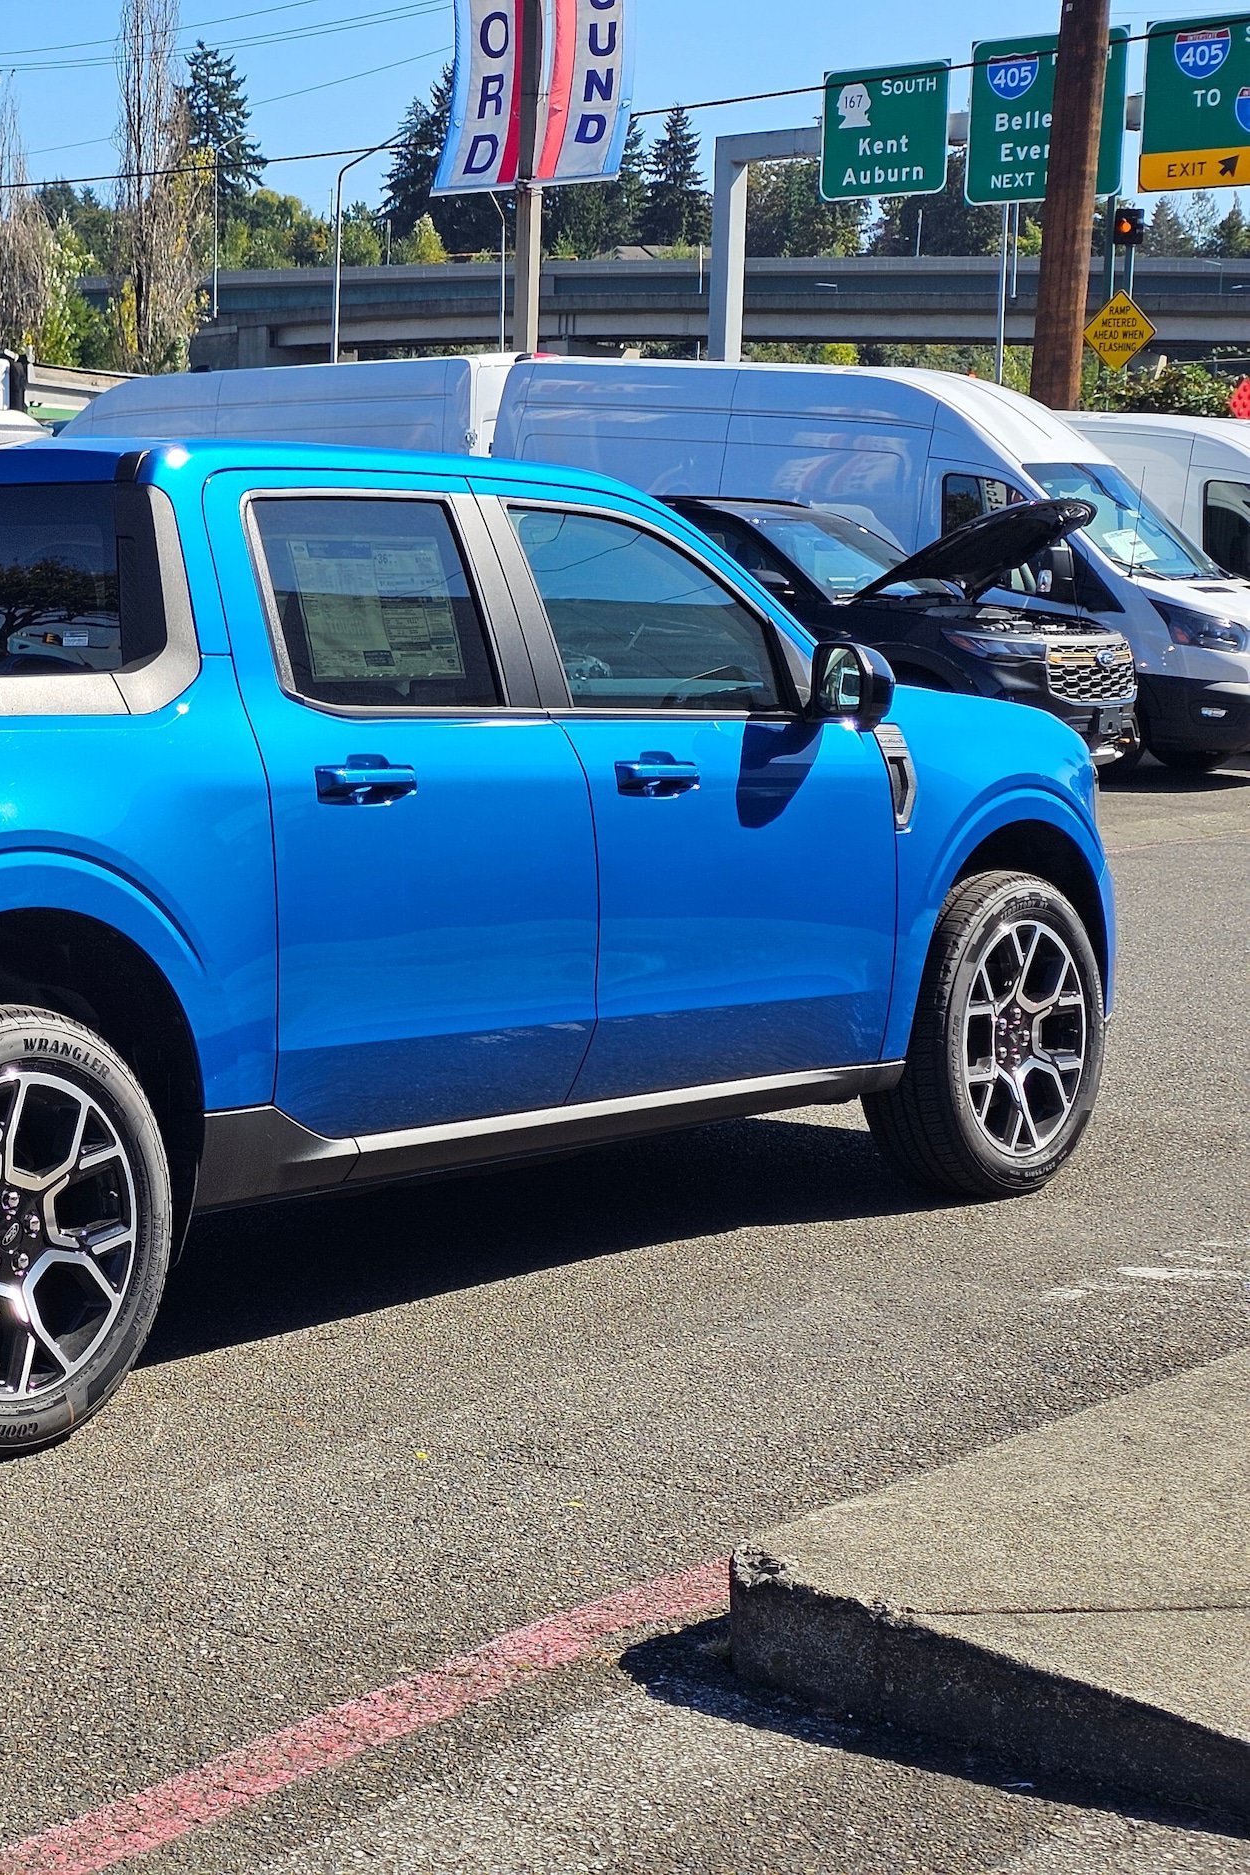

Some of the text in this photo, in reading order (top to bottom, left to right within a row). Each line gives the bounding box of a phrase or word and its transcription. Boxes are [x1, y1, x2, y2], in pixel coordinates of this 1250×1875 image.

[1180, 43, 1223, 67] 405
[993, 66, 1033, 88] 405
[881, 77, 937, 95] SOUTH
[844, 95, 863, 109] 167
[1193, 88, 1221, 108] TO
[858, 135, 908, 156] Kent
[842, 166, 924, 186] Auburn
[1166, 161, 1207, 178] EXIT
[990, 172, 1035, 189] NEXT
[1109, 306, 1130, 315] RAMP
[1101, 318, 1137, 328] METERED
[1093, 330, 1144, 340] AHEAD WHEN
[1098, 342, 1137, 352] FLASHING
[23, 1038, 111, 1080] WRANGLER
